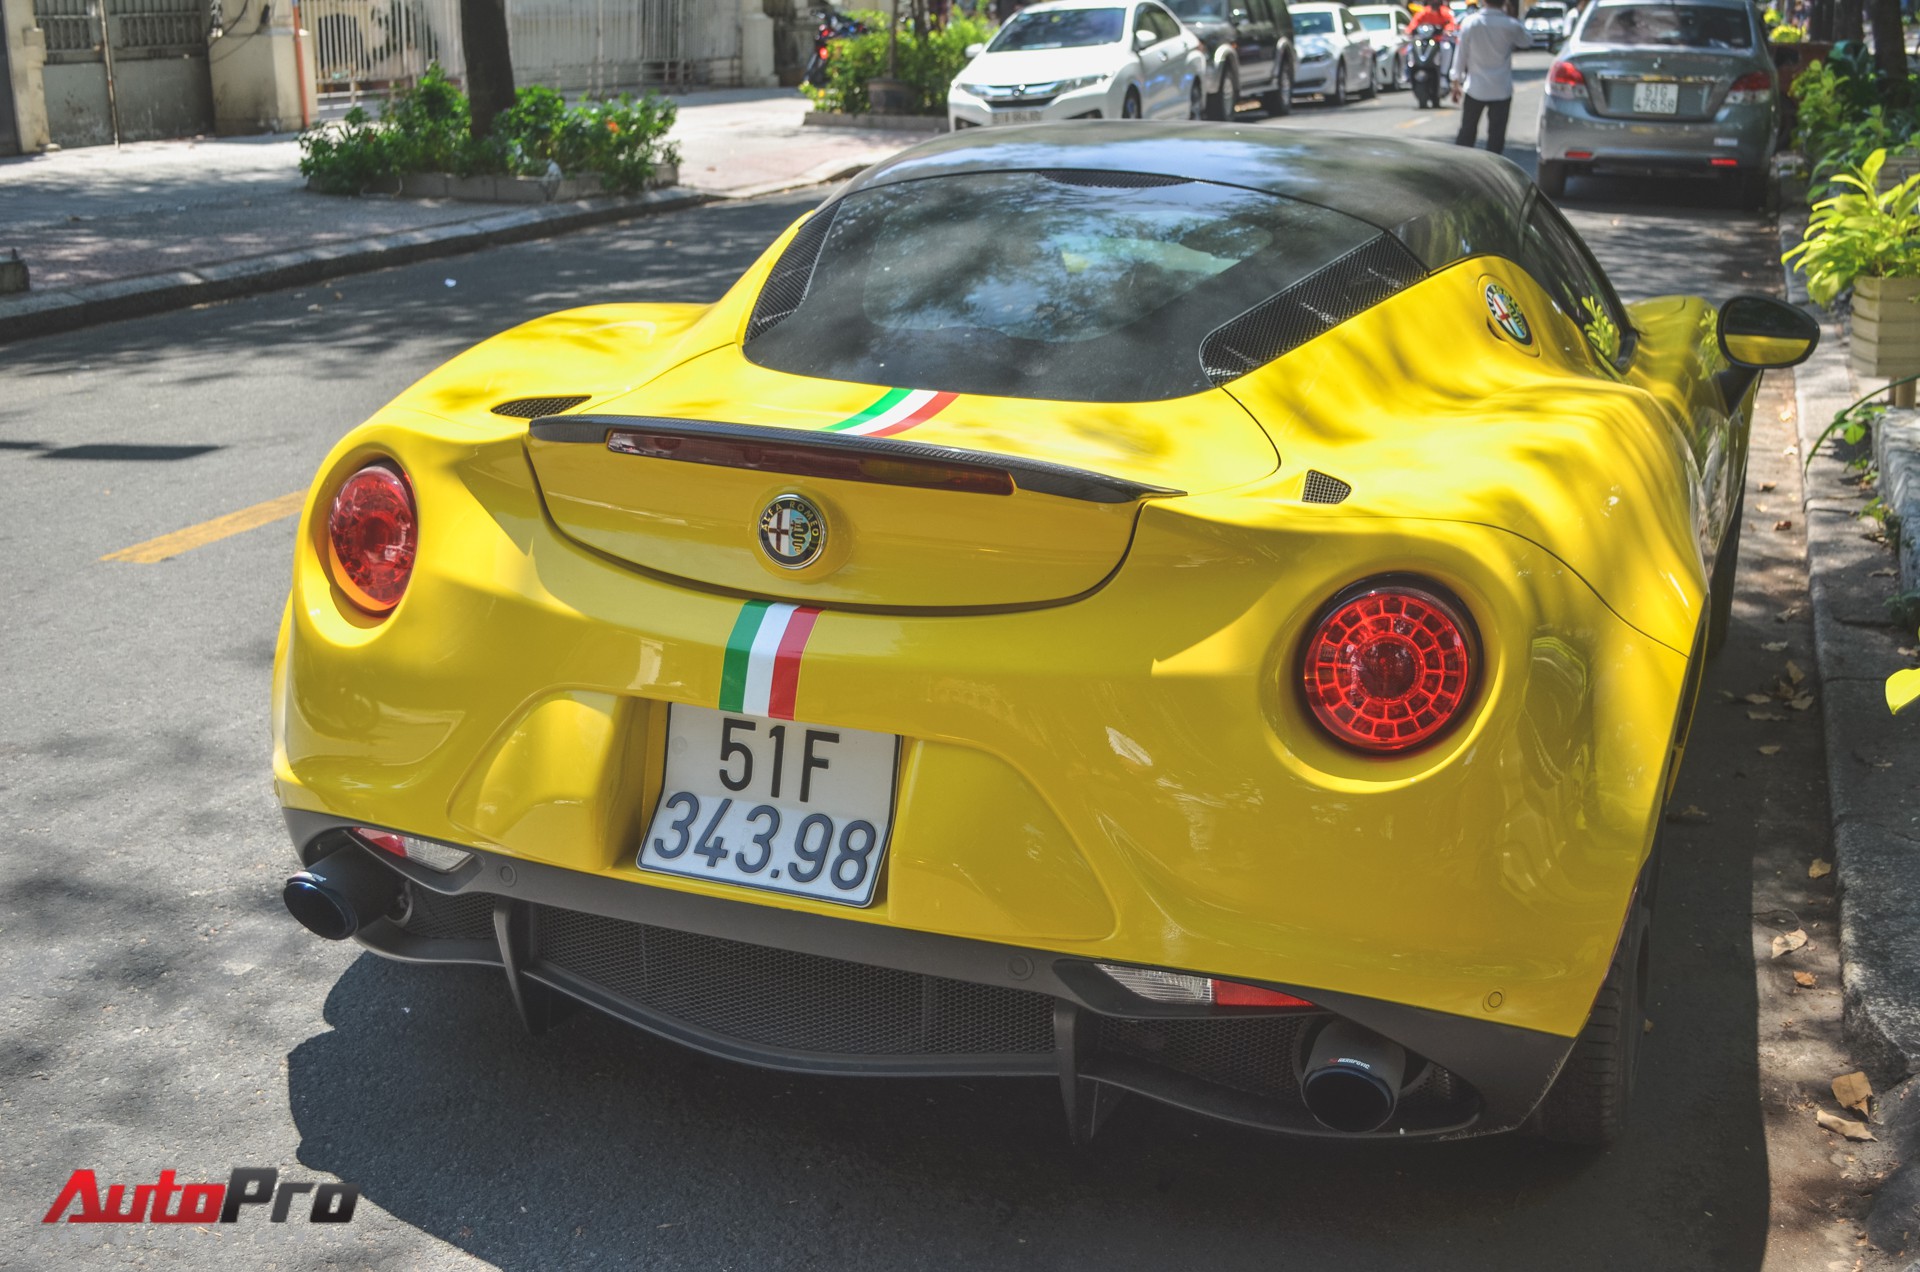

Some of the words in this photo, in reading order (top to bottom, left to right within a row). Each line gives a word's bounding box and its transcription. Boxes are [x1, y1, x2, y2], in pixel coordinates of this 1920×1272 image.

[762, 502, 783, 532] ALFA
[789, 502, 819, 536] ROMEO
[719, 717, 840, 802] 51F
[653, 791, 877, 890] 343.98
